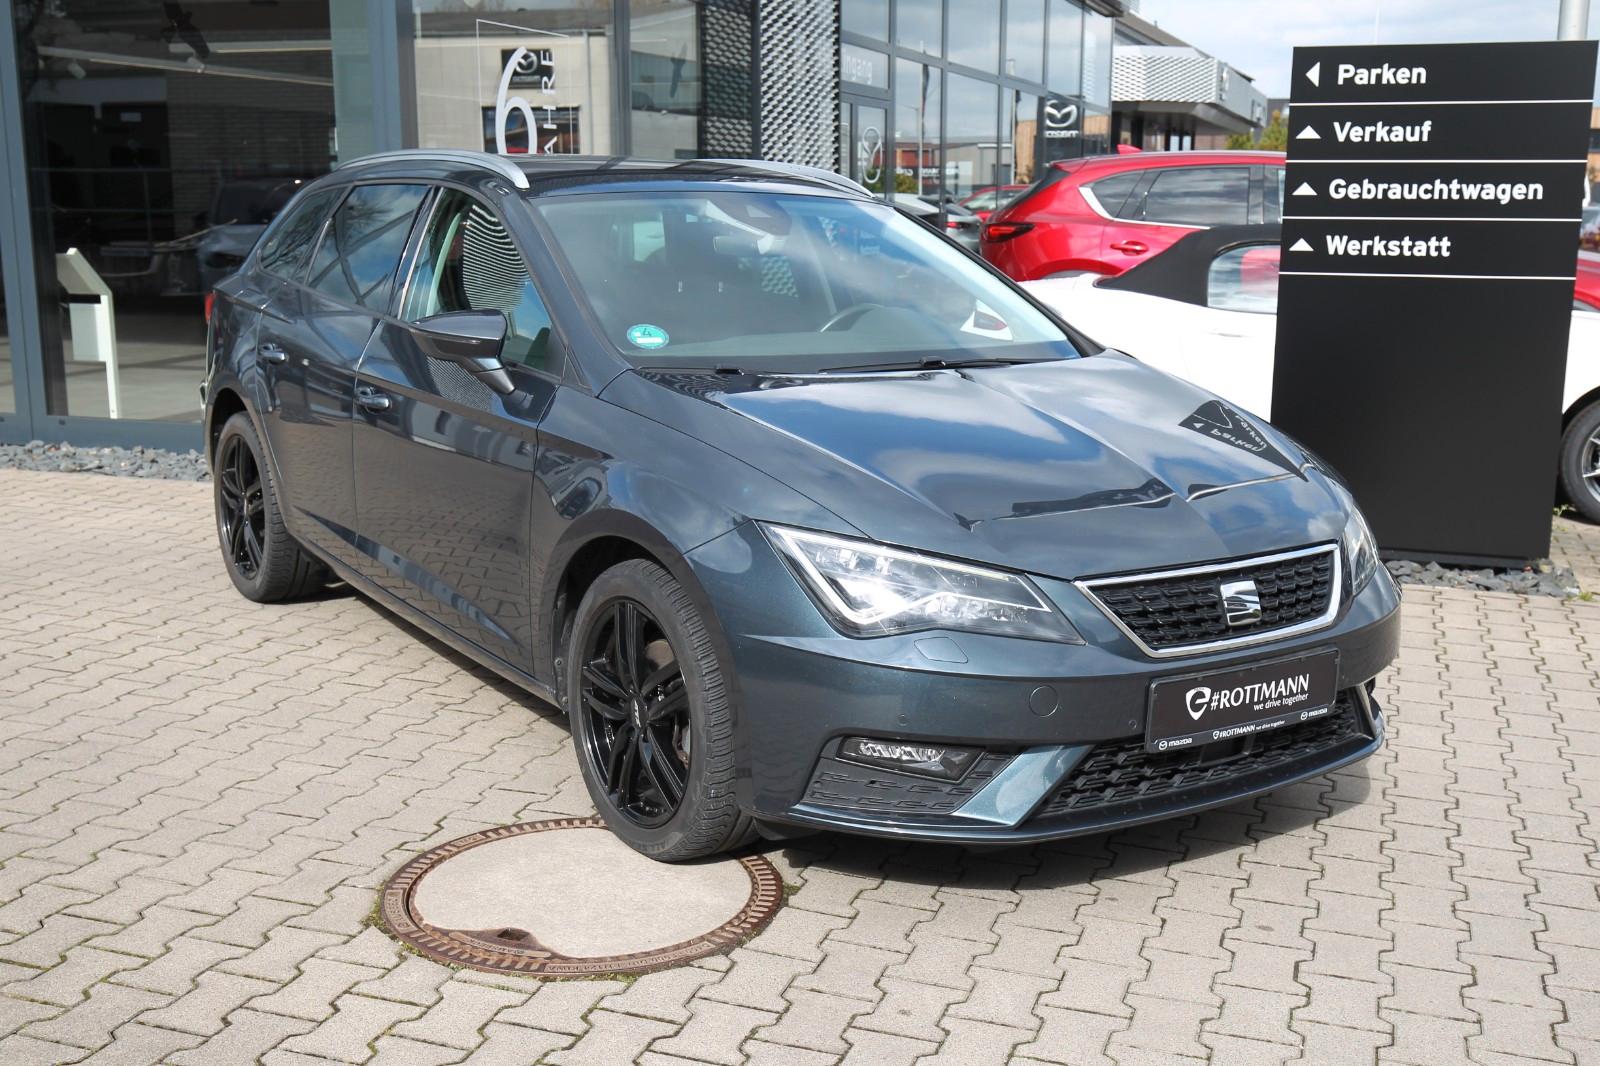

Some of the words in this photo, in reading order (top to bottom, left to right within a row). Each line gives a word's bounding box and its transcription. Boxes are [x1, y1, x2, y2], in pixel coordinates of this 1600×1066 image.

[1337, 63, 1427, 85] Parken
[1333, 120, 1432, 143] Verkauf
[1328, 178, 1544, 205] Gebrauchtwagen
[1325, 234, 1451, 257] Werkstatt
[1253, 702, 1264, 712] we
[1265, 697, 1282, 710] drive
[1282, 692, 1309, 707] together
[1168, 737, 1192, 748] mazda
